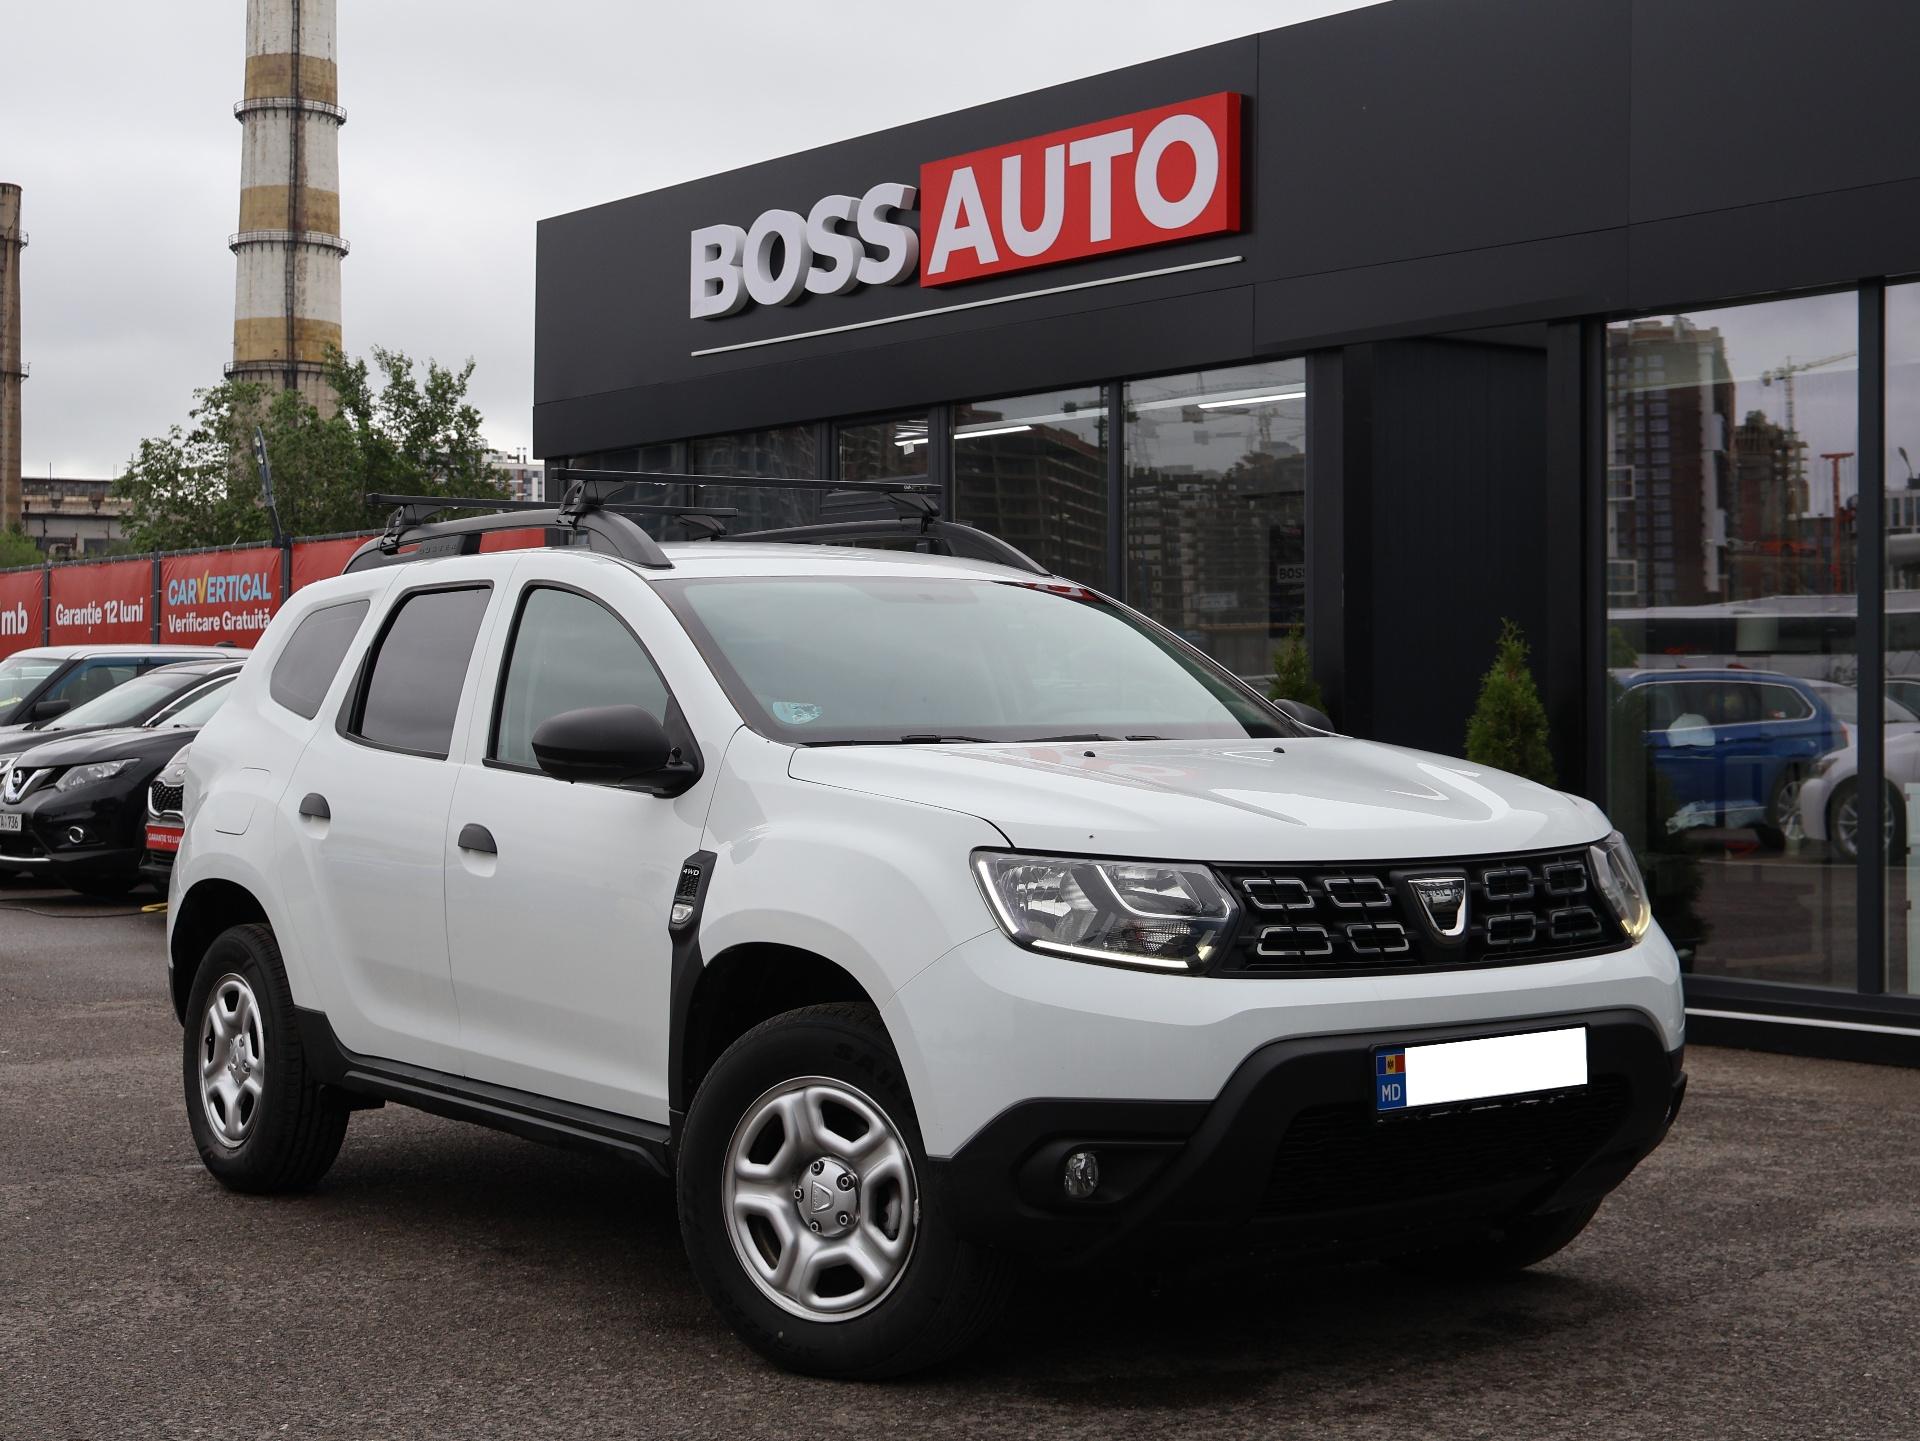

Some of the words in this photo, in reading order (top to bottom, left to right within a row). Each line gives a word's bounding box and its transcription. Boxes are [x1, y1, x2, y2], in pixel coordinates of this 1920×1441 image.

[690, 183, 918, 319] BOSS
[927, 114, 1219, 276] AUTO
[168, 569, 272, 606] CARVERTICAL
[56, 600, 102, 635] Garanție
[104, 600, 118, 624] 12
[120, 597, 144, 623] luni
[168, 611, 220, 633] Verificare
[222, 608, 271, 631] Gratuită
[683, 868, 699, 876] 4WD
[1381, 1083, 1400, 1103] MD
